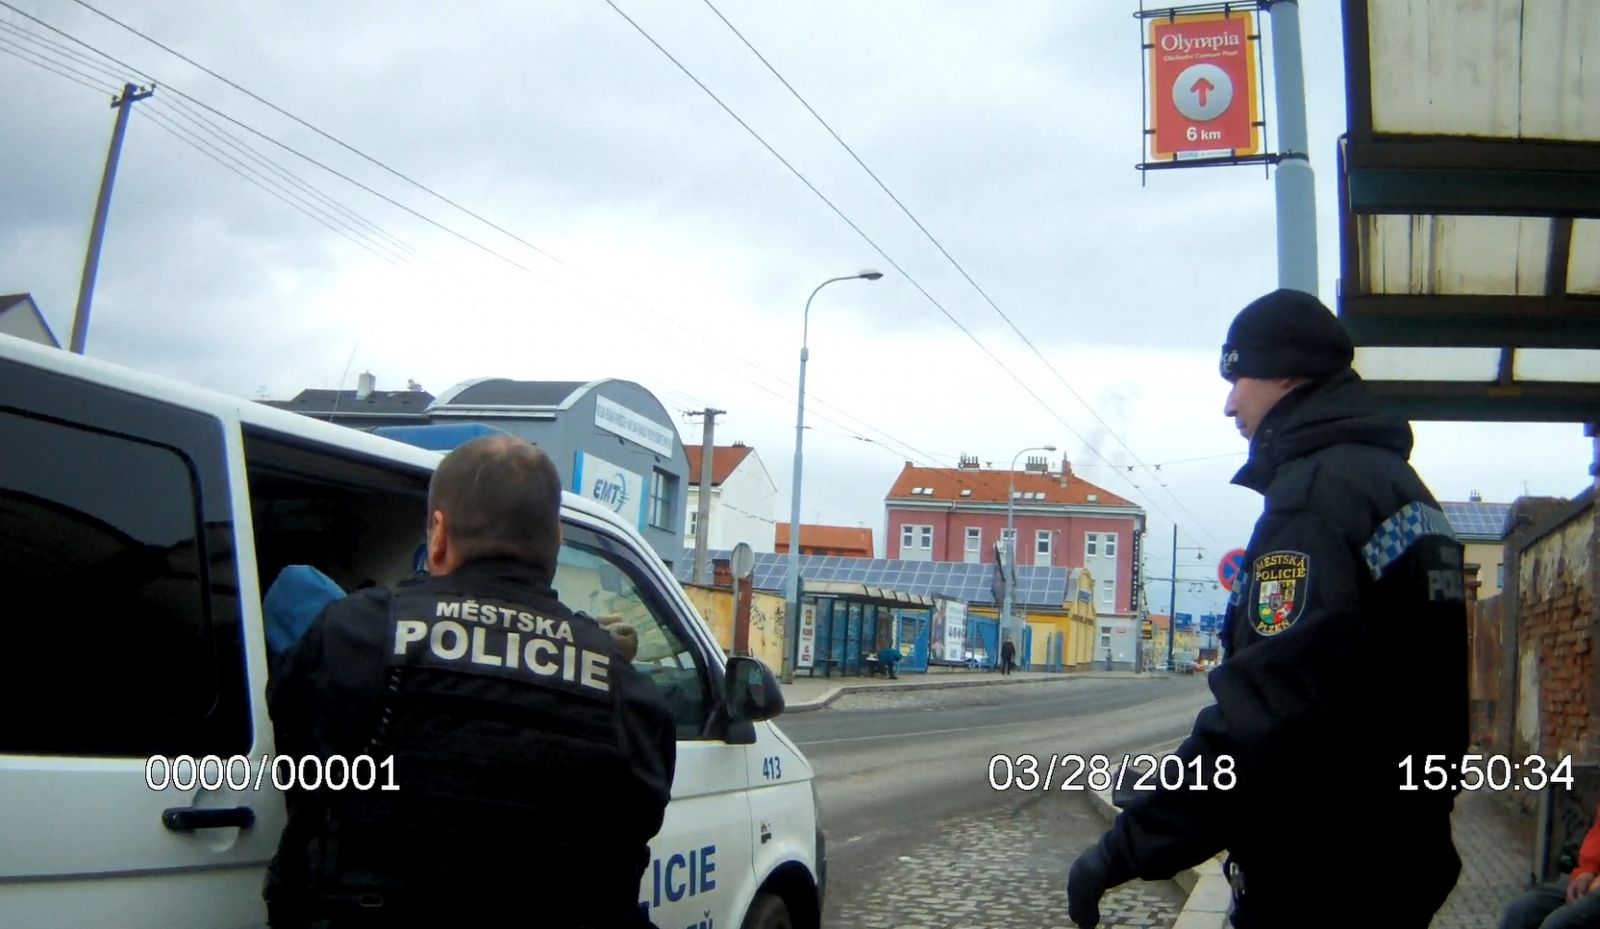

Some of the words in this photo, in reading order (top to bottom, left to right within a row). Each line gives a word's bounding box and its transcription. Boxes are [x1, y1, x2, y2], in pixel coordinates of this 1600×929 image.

[1161, 31, 1240, 52] Olympia
[1186, 127, 1198, 141] 6
[1201, 129, 1221, 140] km
[593, 478, 622, 505] EMT
[1255, 567, 1307, 582] POLICIE
[393, 620, 611, 692] POLICIE
[762, 756, 782, 780] 413
[638, 845, 717, 909] ICIE
